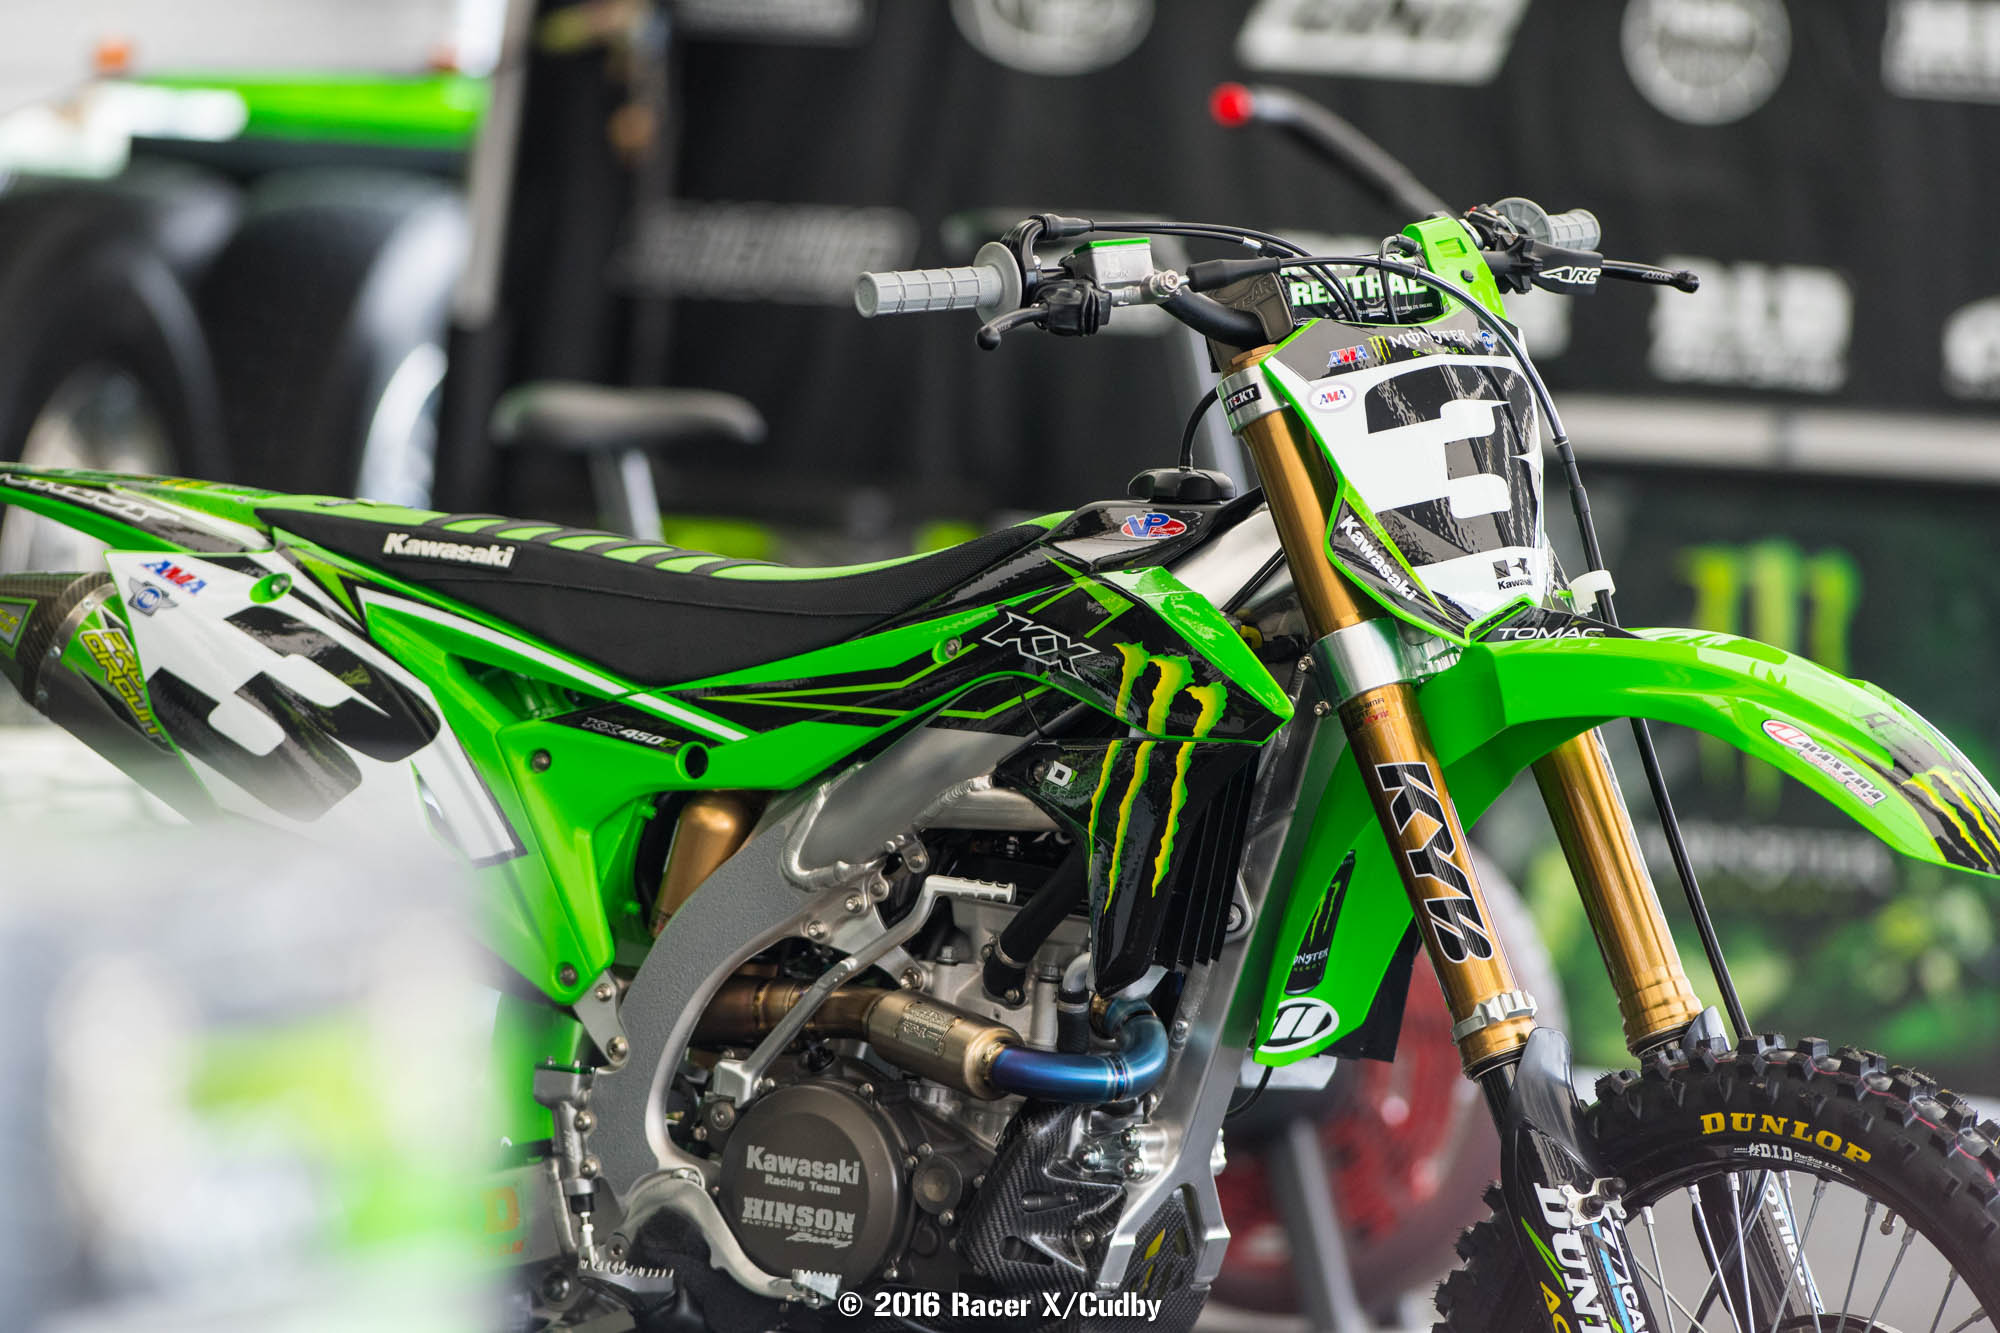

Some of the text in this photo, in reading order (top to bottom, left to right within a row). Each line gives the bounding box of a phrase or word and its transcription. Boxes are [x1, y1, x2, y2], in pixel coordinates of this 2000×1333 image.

[1538, 266, 1602, 284] ARC
[1327, 344, 1369, 369] AMA
[1319, 389, 1347, 405] AMA
[1364, 364, 1540, 568] 3
[1126, 513, 1170, 538] VP
[383, 532, 516, 568] Kawasaki
[1339, 514, 1418, 601] Kawasaki
[140, 560, 207, 597] AMA
[1498, 627, 1605, 640] TOMAC
[145, 605, 441, 823] 3
[1375, 762, 1494, 963] KYB
[1700, 1112, 1872, 1164] DUNLOP
[746, 1145, 860, 1185] Kawasaki
[764, 1173, 841, 1195] Racing Team
[742, 1196, 856, 1234] HINSON
